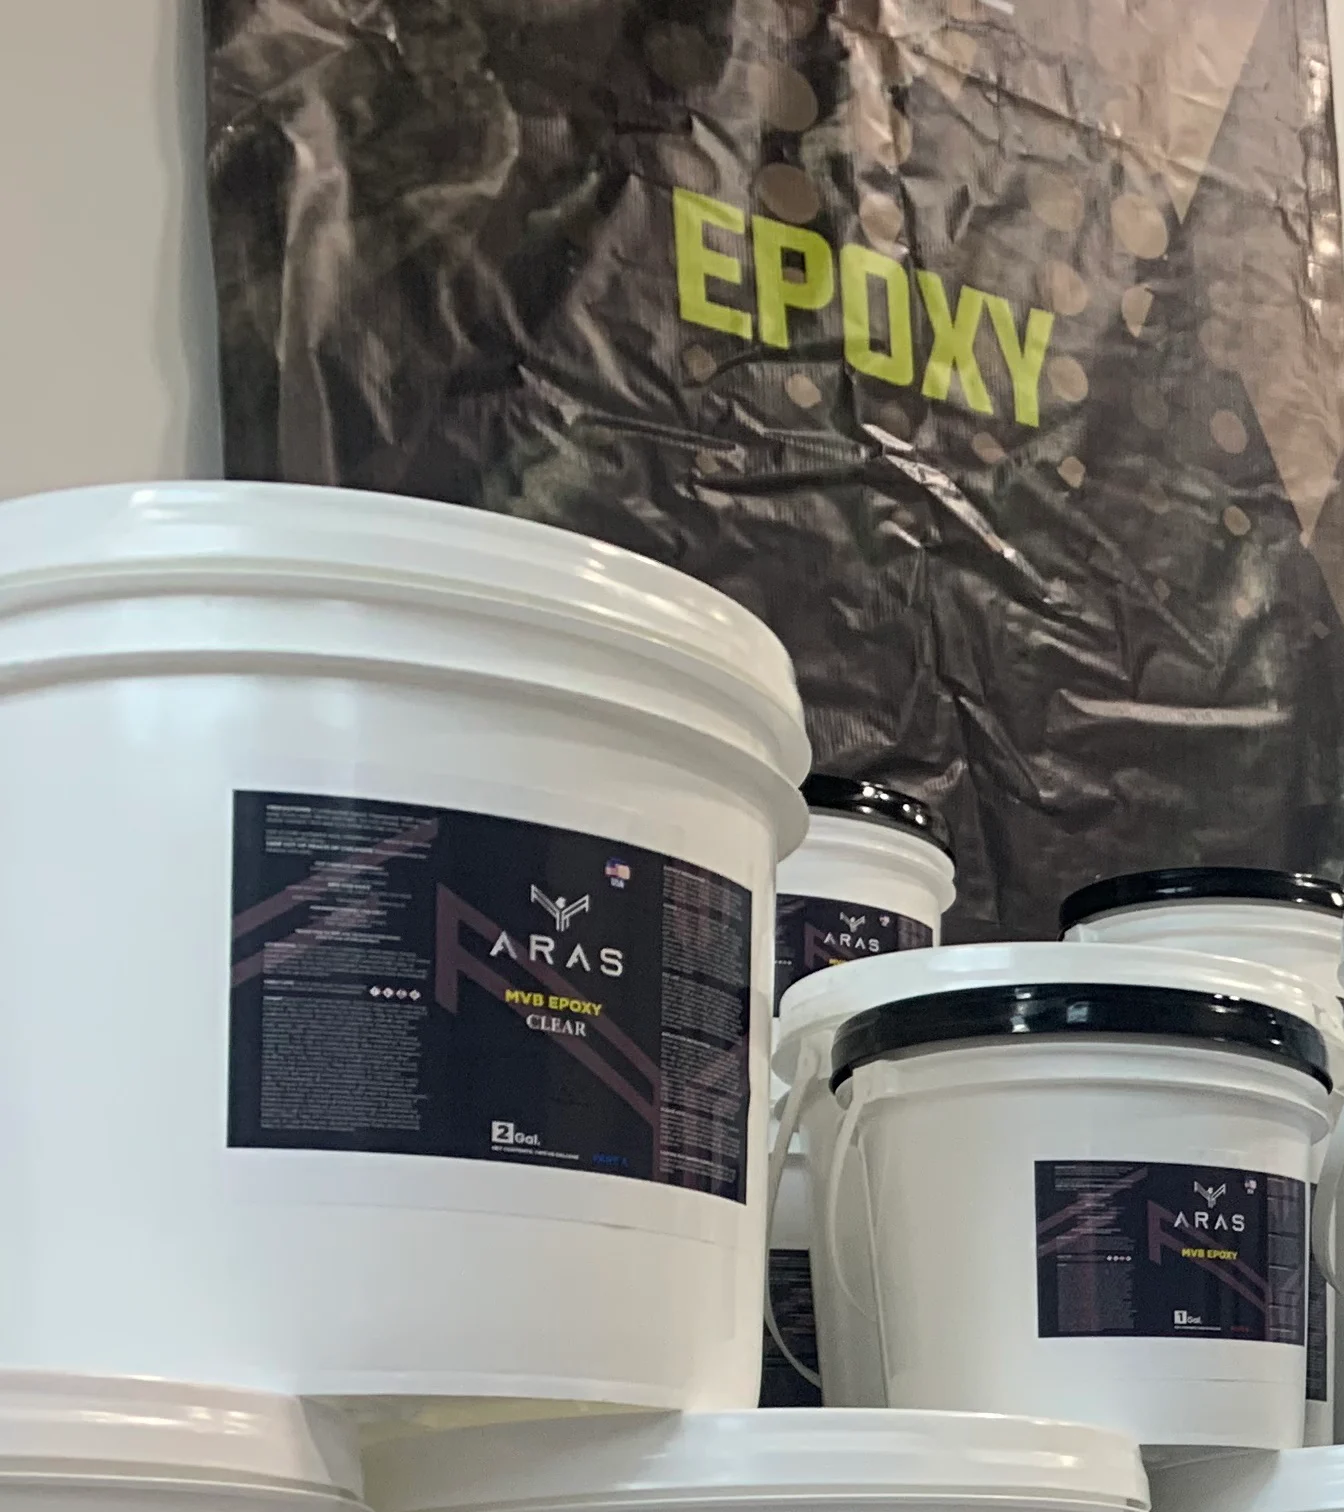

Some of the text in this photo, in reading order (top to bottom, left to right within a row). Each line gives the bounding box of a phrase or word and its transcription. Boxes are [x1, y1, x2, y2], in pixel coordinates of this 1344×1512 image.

[671, 186, 1055, 428] EPOXY
[489, 930, 623, 977] ARAS
[824, 932, 880, 952] ARAS
[505, 989, 602, 1016] MVB EPOXY
[526, 1013, 586, 1037] CLEAR
[497, 1125, 509, 1140] 2
[1174, 1211, 1245, 1232] ARAS
